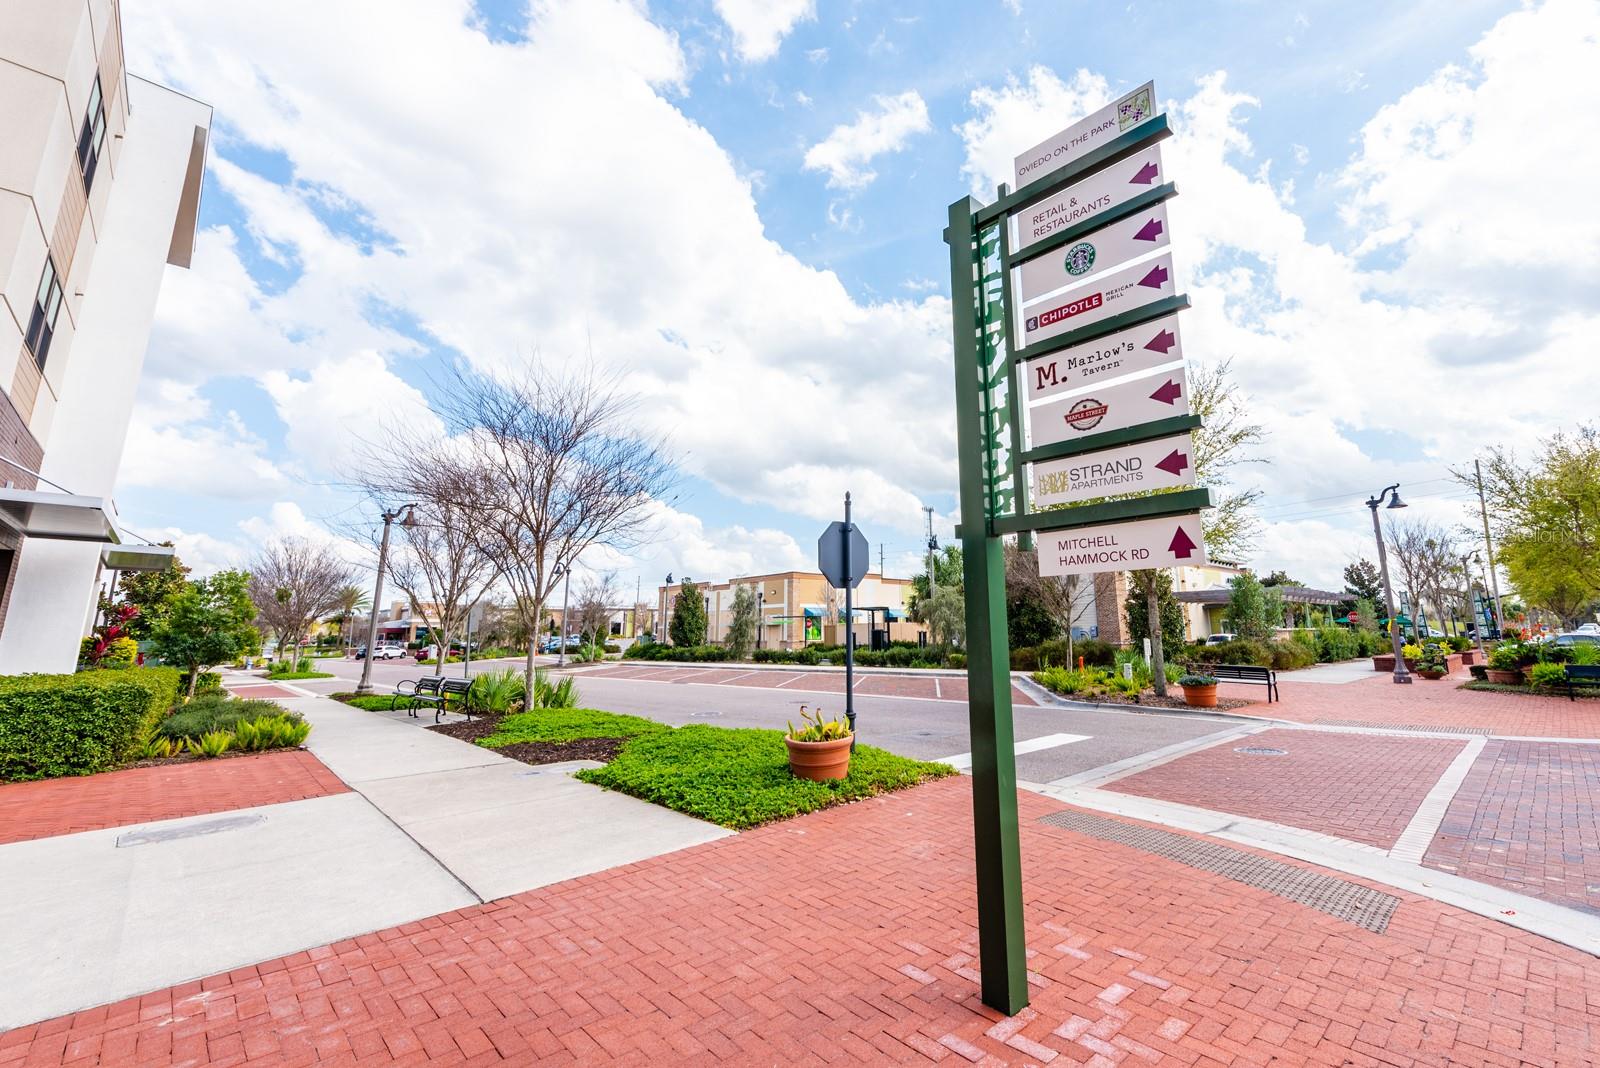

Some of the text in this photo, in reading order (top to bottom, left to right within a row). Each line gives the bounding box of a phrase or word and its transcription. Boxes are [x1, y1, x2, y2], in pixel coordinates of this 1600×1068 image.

[1018, 118, 1116, 176] OVIEDO ON THE PARK
[1032, 196, 1078, 226] RETAIL &
[1033, 194, 1111, 238] RESTAURANTS
[1105, 282, 1134, 297] MEXICAN
[1105, 291, 1125, 302] GRILL
[1041, 294, 1101, 325] CHIPOTLE
[1067, 342, 1135, 370] Marlow's
[1035, 361, 1068, 391] M.
[1081, 360, 1121, 377] Tavern
[1066, 407, 1106, 421] MAPLE STREET
[1069, 456, 1142, 482] STRAND
[1070, 471, 1144, 491] APARTMENTS
[1058, 535, 1119, 551] MITCHELL
[1059, 548, 1150, 567] HAMMOCK RD
